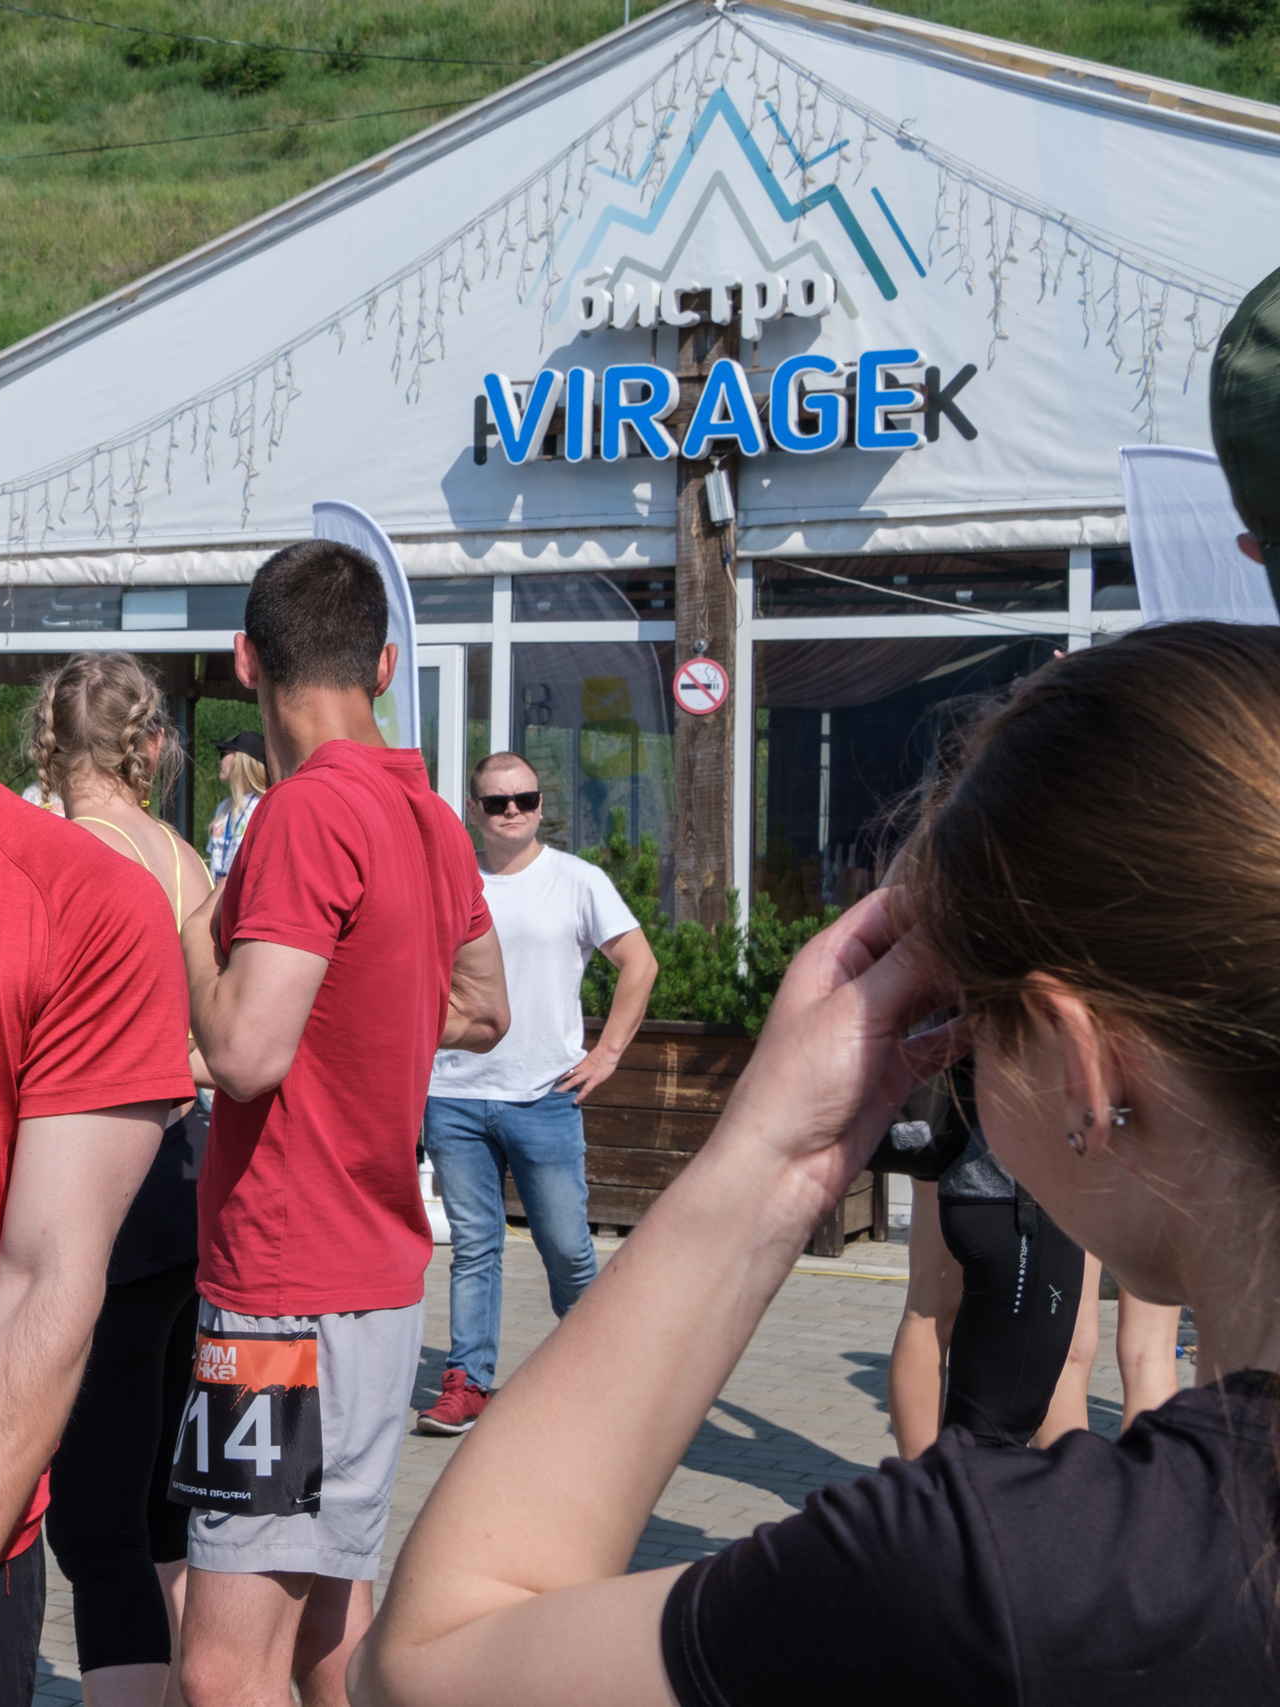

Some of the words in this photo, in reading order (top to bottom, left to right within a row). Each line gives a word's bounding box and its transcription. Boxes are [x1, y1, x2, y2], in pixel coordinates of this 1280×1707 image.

[570, 267, 838, 341] бистро
[483, 349, 927, 466] VIRAGE
[209, 1489, 251, 1500] ПРОФИ
